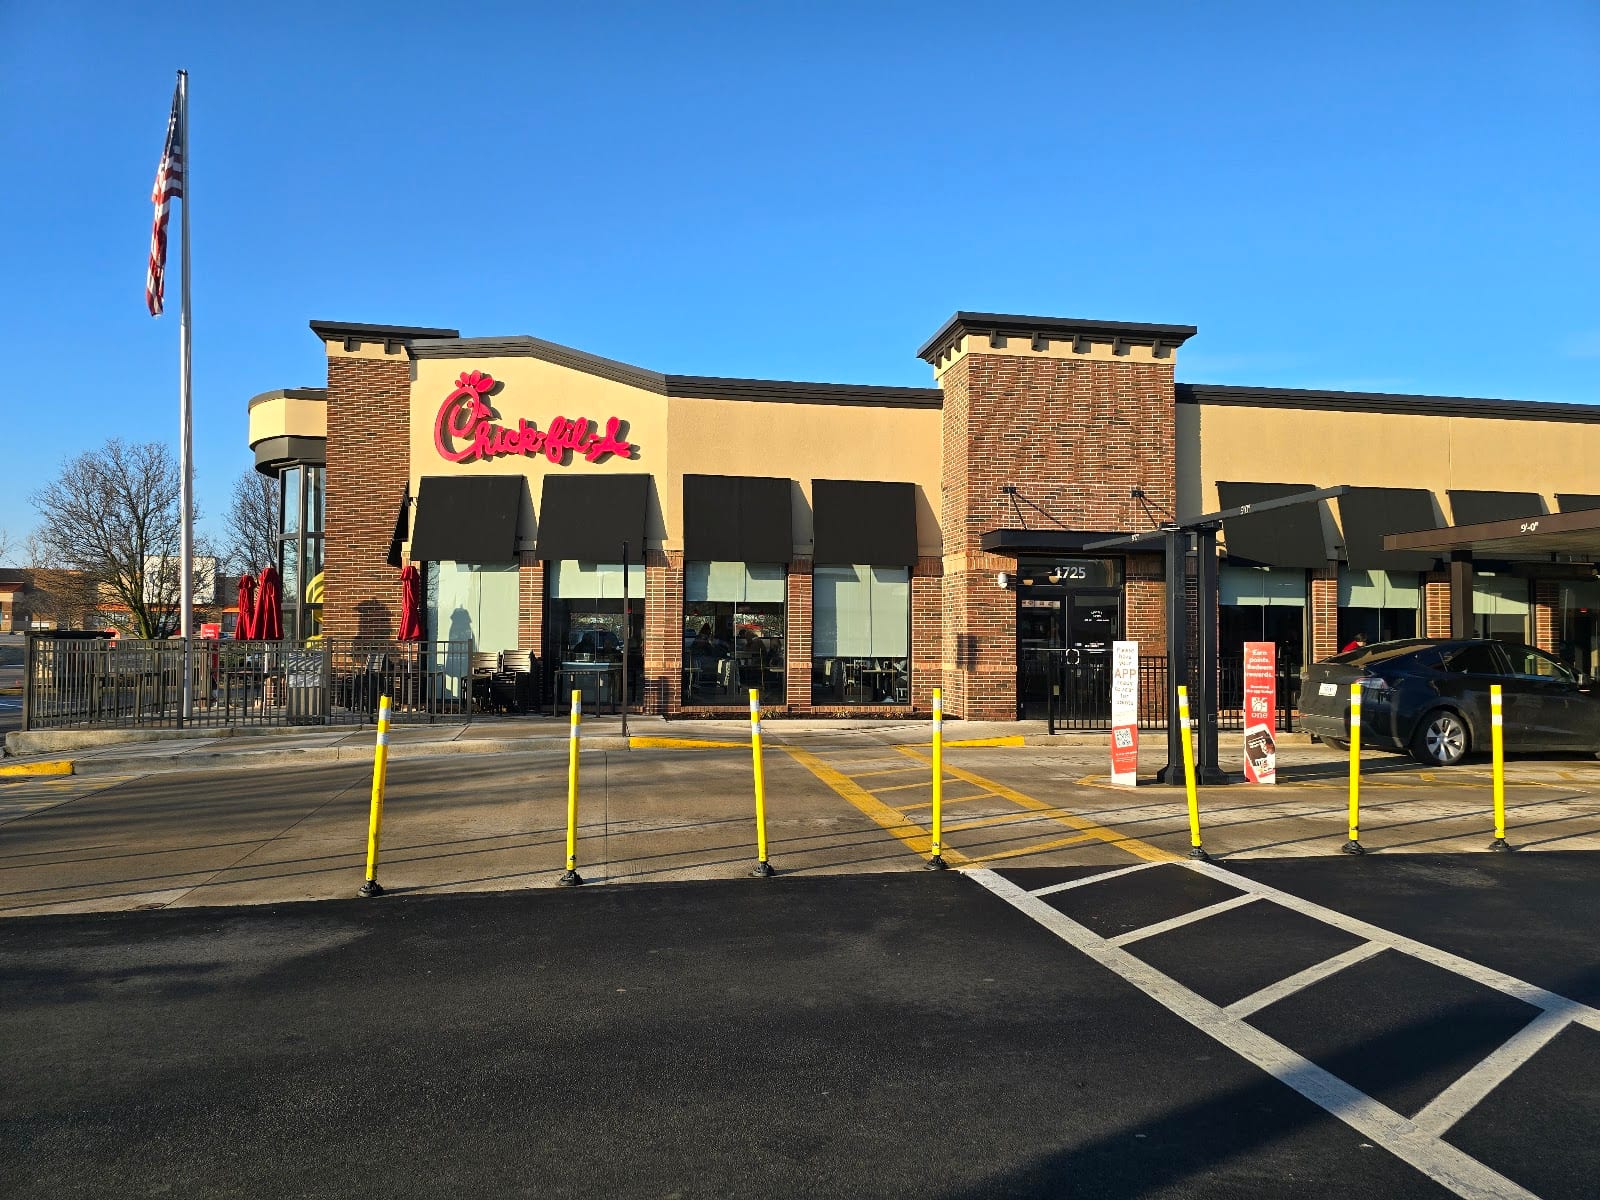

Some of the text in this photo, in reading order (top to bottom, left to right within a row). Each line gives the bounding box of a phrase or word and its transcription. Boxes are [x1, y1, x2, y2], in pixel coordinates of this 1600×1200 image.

[434, 370, 631, 463] Chick-fil-A
[1054, 566, 1086, 579] 1725
[1114, 668, 1137, 680] APP
